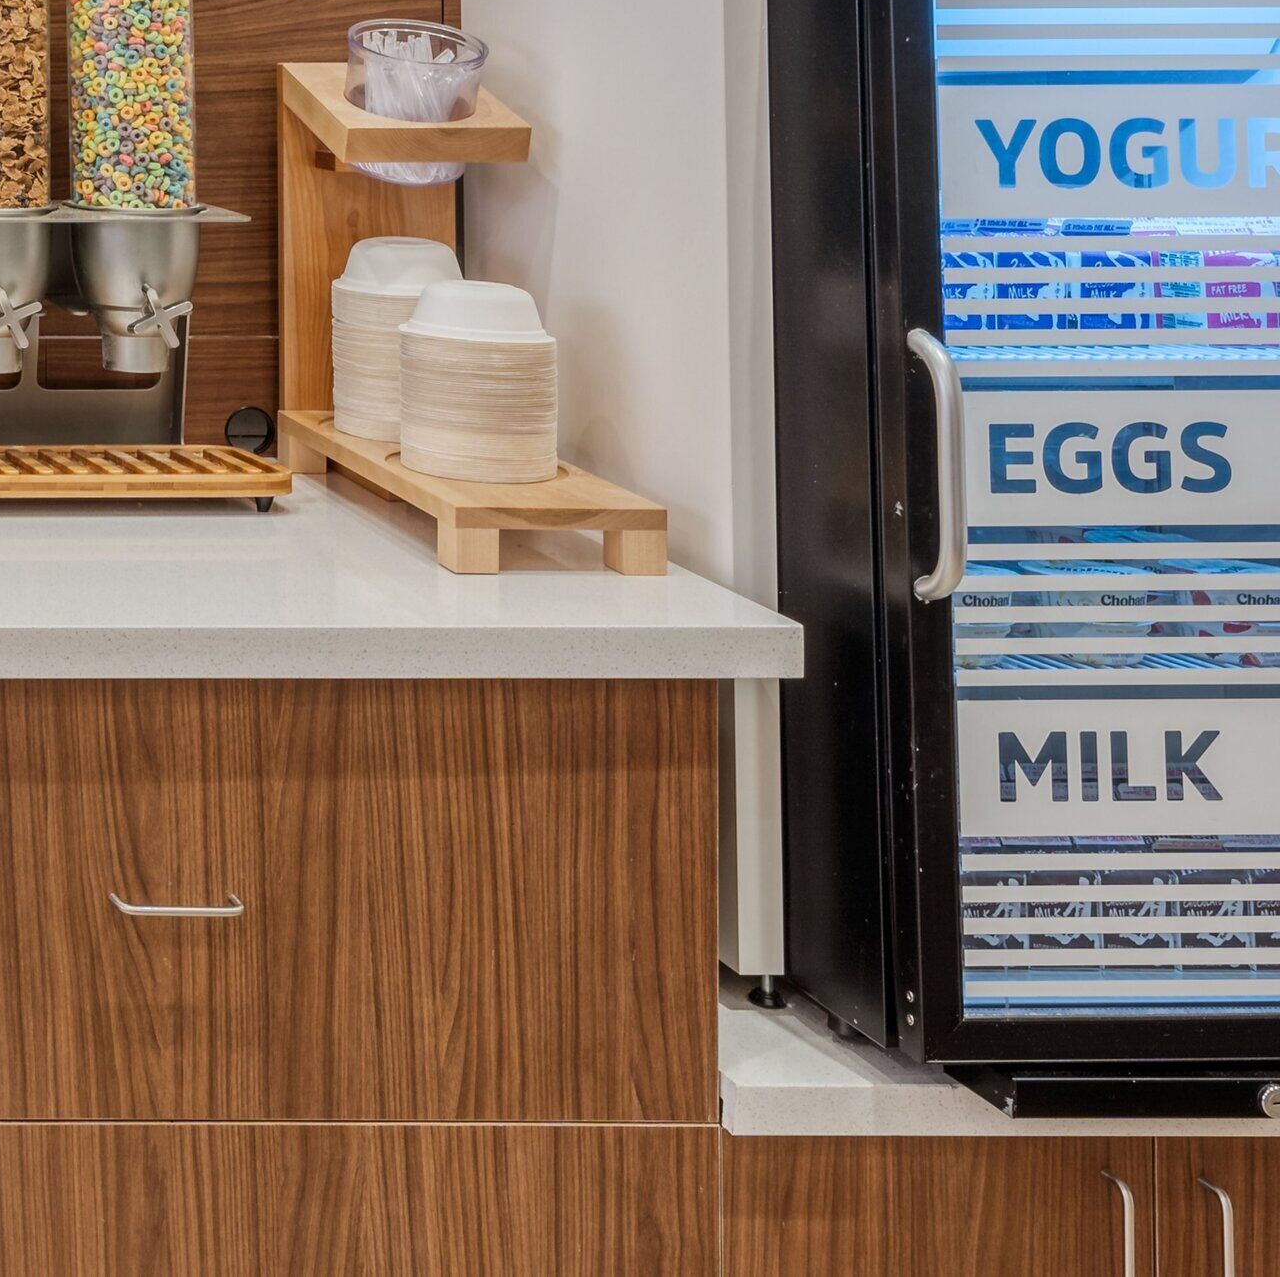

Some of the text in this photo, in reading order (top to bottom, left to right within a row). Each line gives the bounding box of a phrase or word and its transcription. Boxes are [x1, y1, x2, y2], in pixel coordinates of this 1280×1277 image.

[1008, 285, 1035, 299] MILK
[1211, 285, 1227, 296] FAT
[1228, 283, 1248, 294] FREE
[988, 421, 1233, 494] EGGS
[997, 729, 1224, 803] MILK
[1034, 906, 1061, 918] MILK
